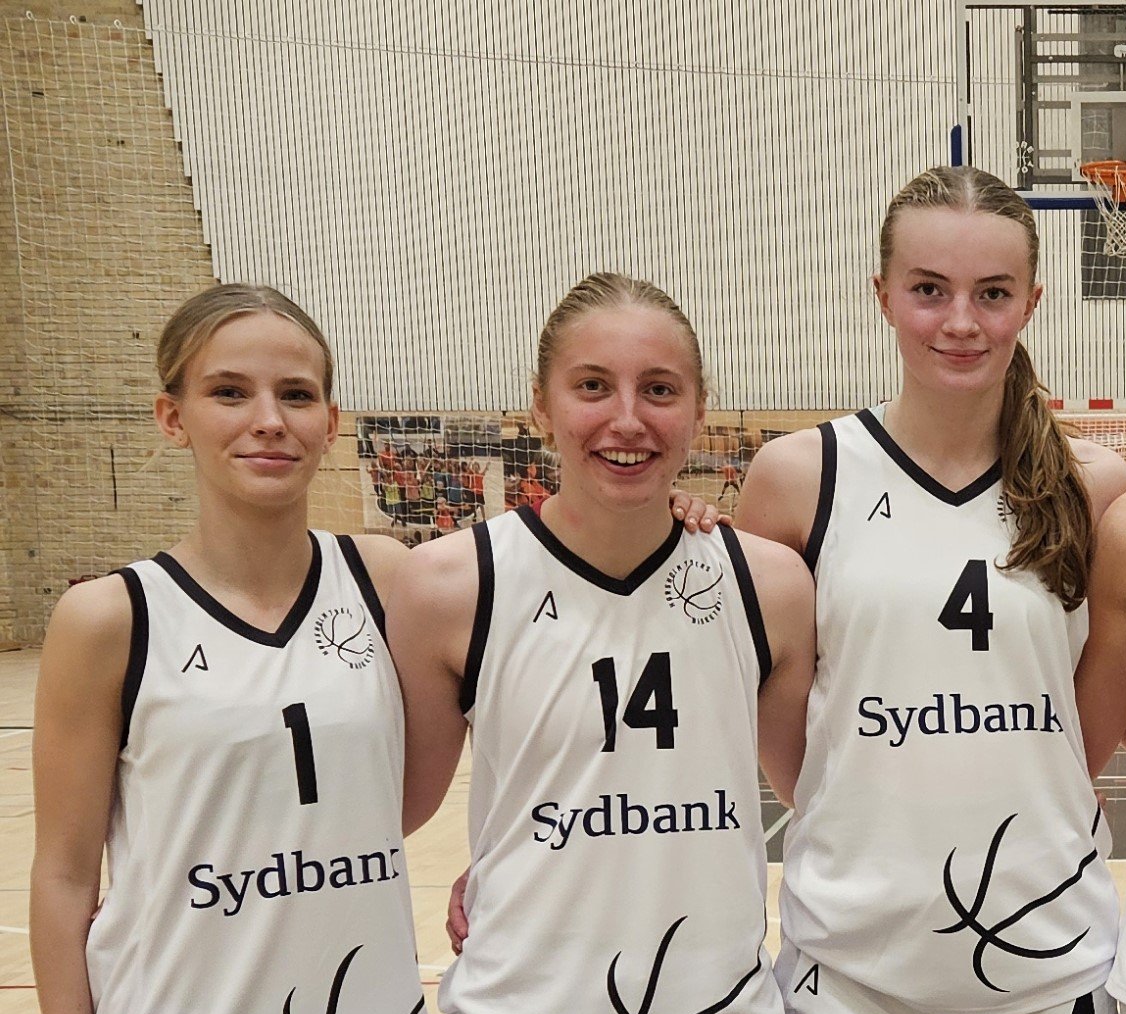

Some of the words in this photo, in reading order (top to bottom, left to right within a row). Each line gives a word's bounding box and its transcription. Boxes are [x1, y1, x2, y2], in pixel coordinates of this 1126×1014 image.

[938, 559, 993, 651] 4
[592, 652, 678, 752] 14
[858, 694, 1064, 748] Sydbank
[282, 702, 318, 805] 1
[531, 790, 740, 850] Sydbank
[188, 848, 399, 917] Sydban
